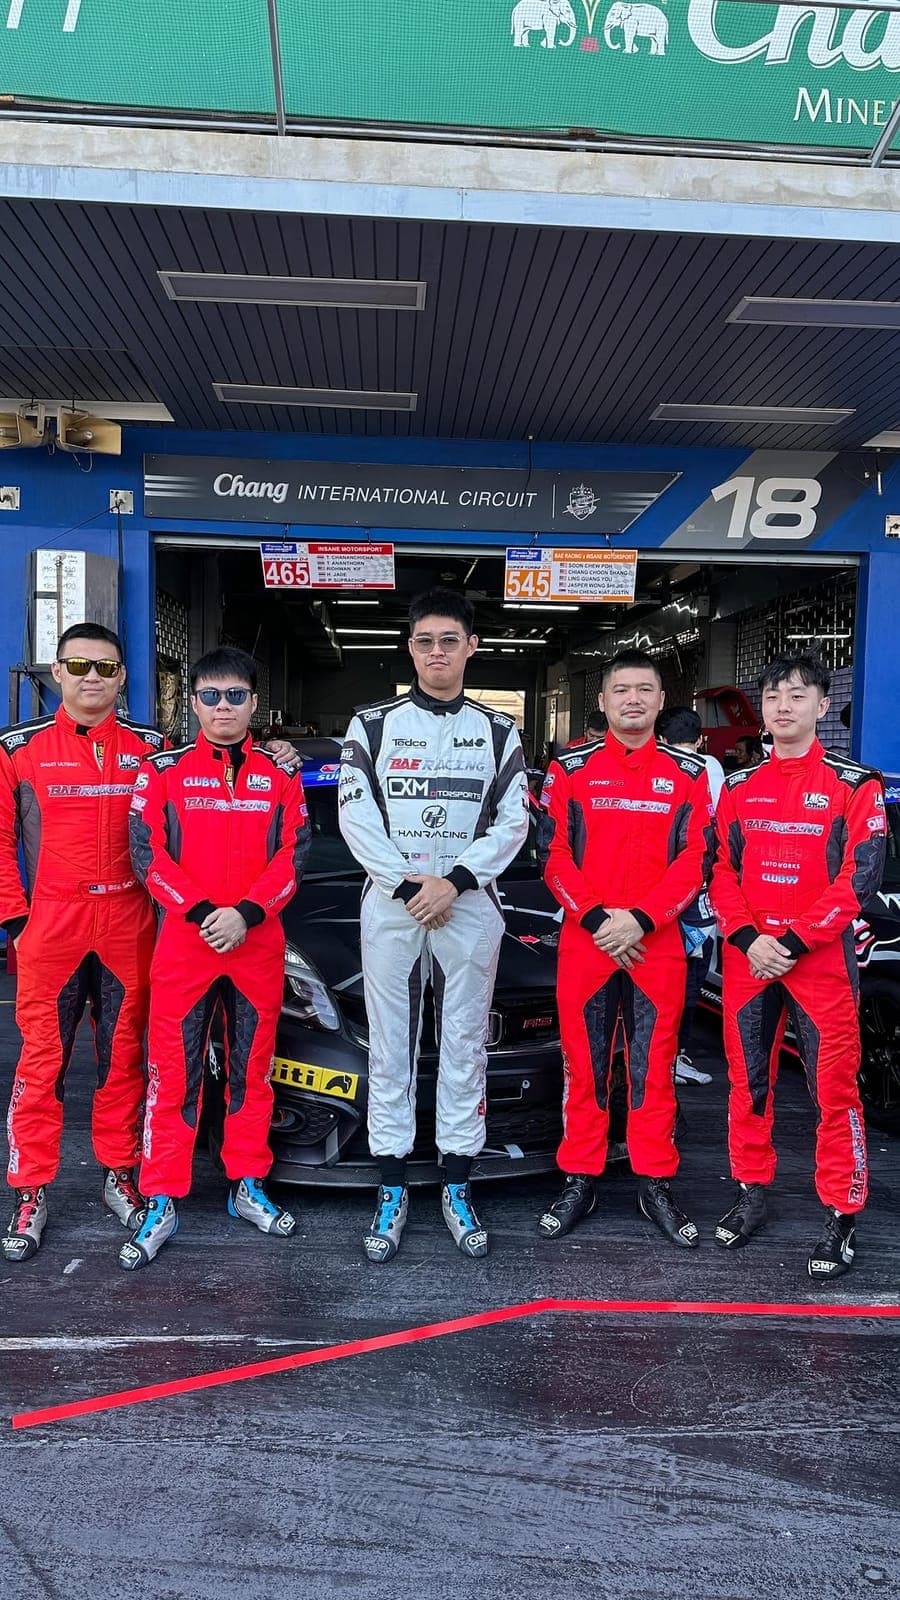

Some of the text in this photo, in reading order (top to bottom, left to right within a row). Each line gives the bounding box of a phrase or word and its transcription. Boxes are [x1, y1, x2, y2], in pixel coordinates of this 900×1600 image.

[793, 87, 900, 125] MINE
[213, 473, 537, 507] Chang INTERNATIONAL CIRCUIT
[711, 477, 822, 539] 18
[266, 562, 309, 585] 465
[507, 571, 550, 597] 545
[341, 749, 354, 760] MP
[392, 738, 427, 748] Tedco
[389, 758, 486, 771] BAE RACING
[272, 1063, 316, 1087] iti
